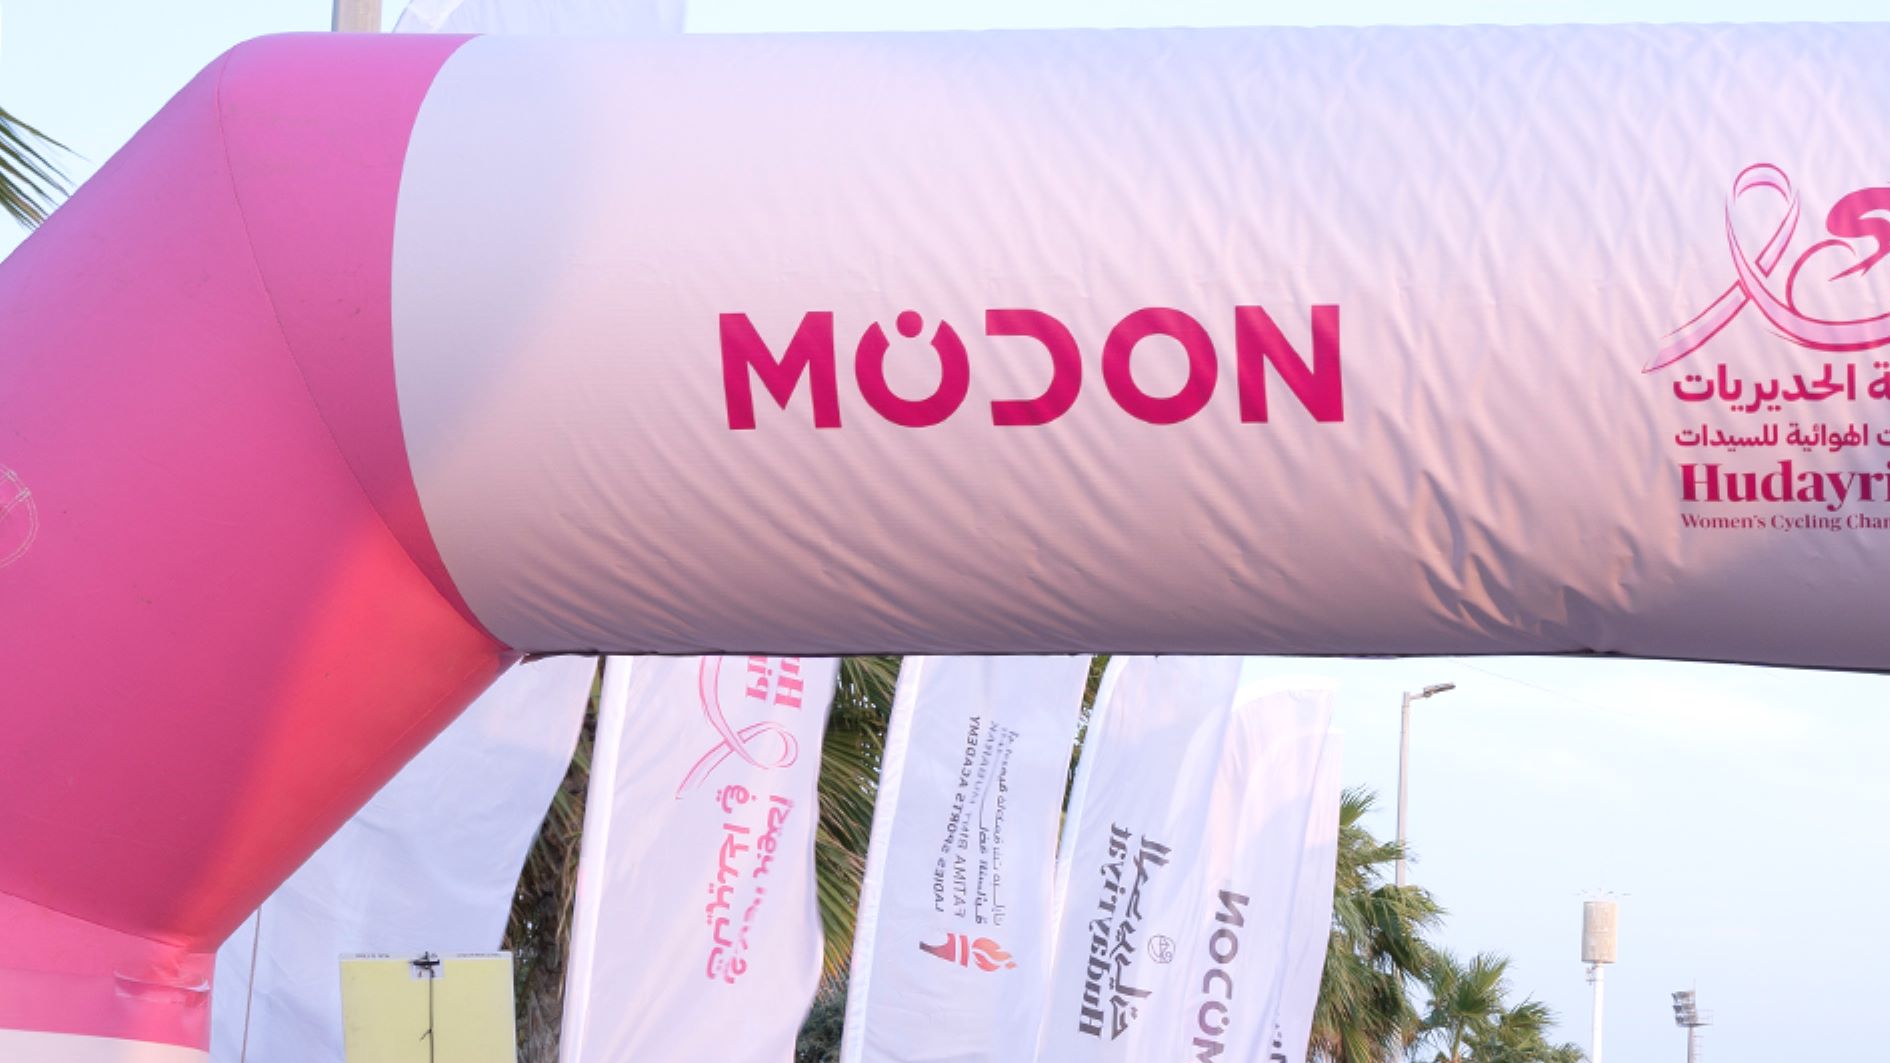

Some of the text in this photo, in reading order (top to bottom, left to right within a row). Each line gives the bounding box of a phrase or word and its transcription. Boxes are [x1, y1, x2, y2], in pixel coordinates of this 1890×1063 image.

[1672, 363, 1857, 413] الحديريات
[1674, 424, 1778, 452] للسيدات
[1786, 422, 1869, 452] الهوائية
[1680, 513, 1767, 530] Women's
[1771, 513, 1842, 532] Cycling
